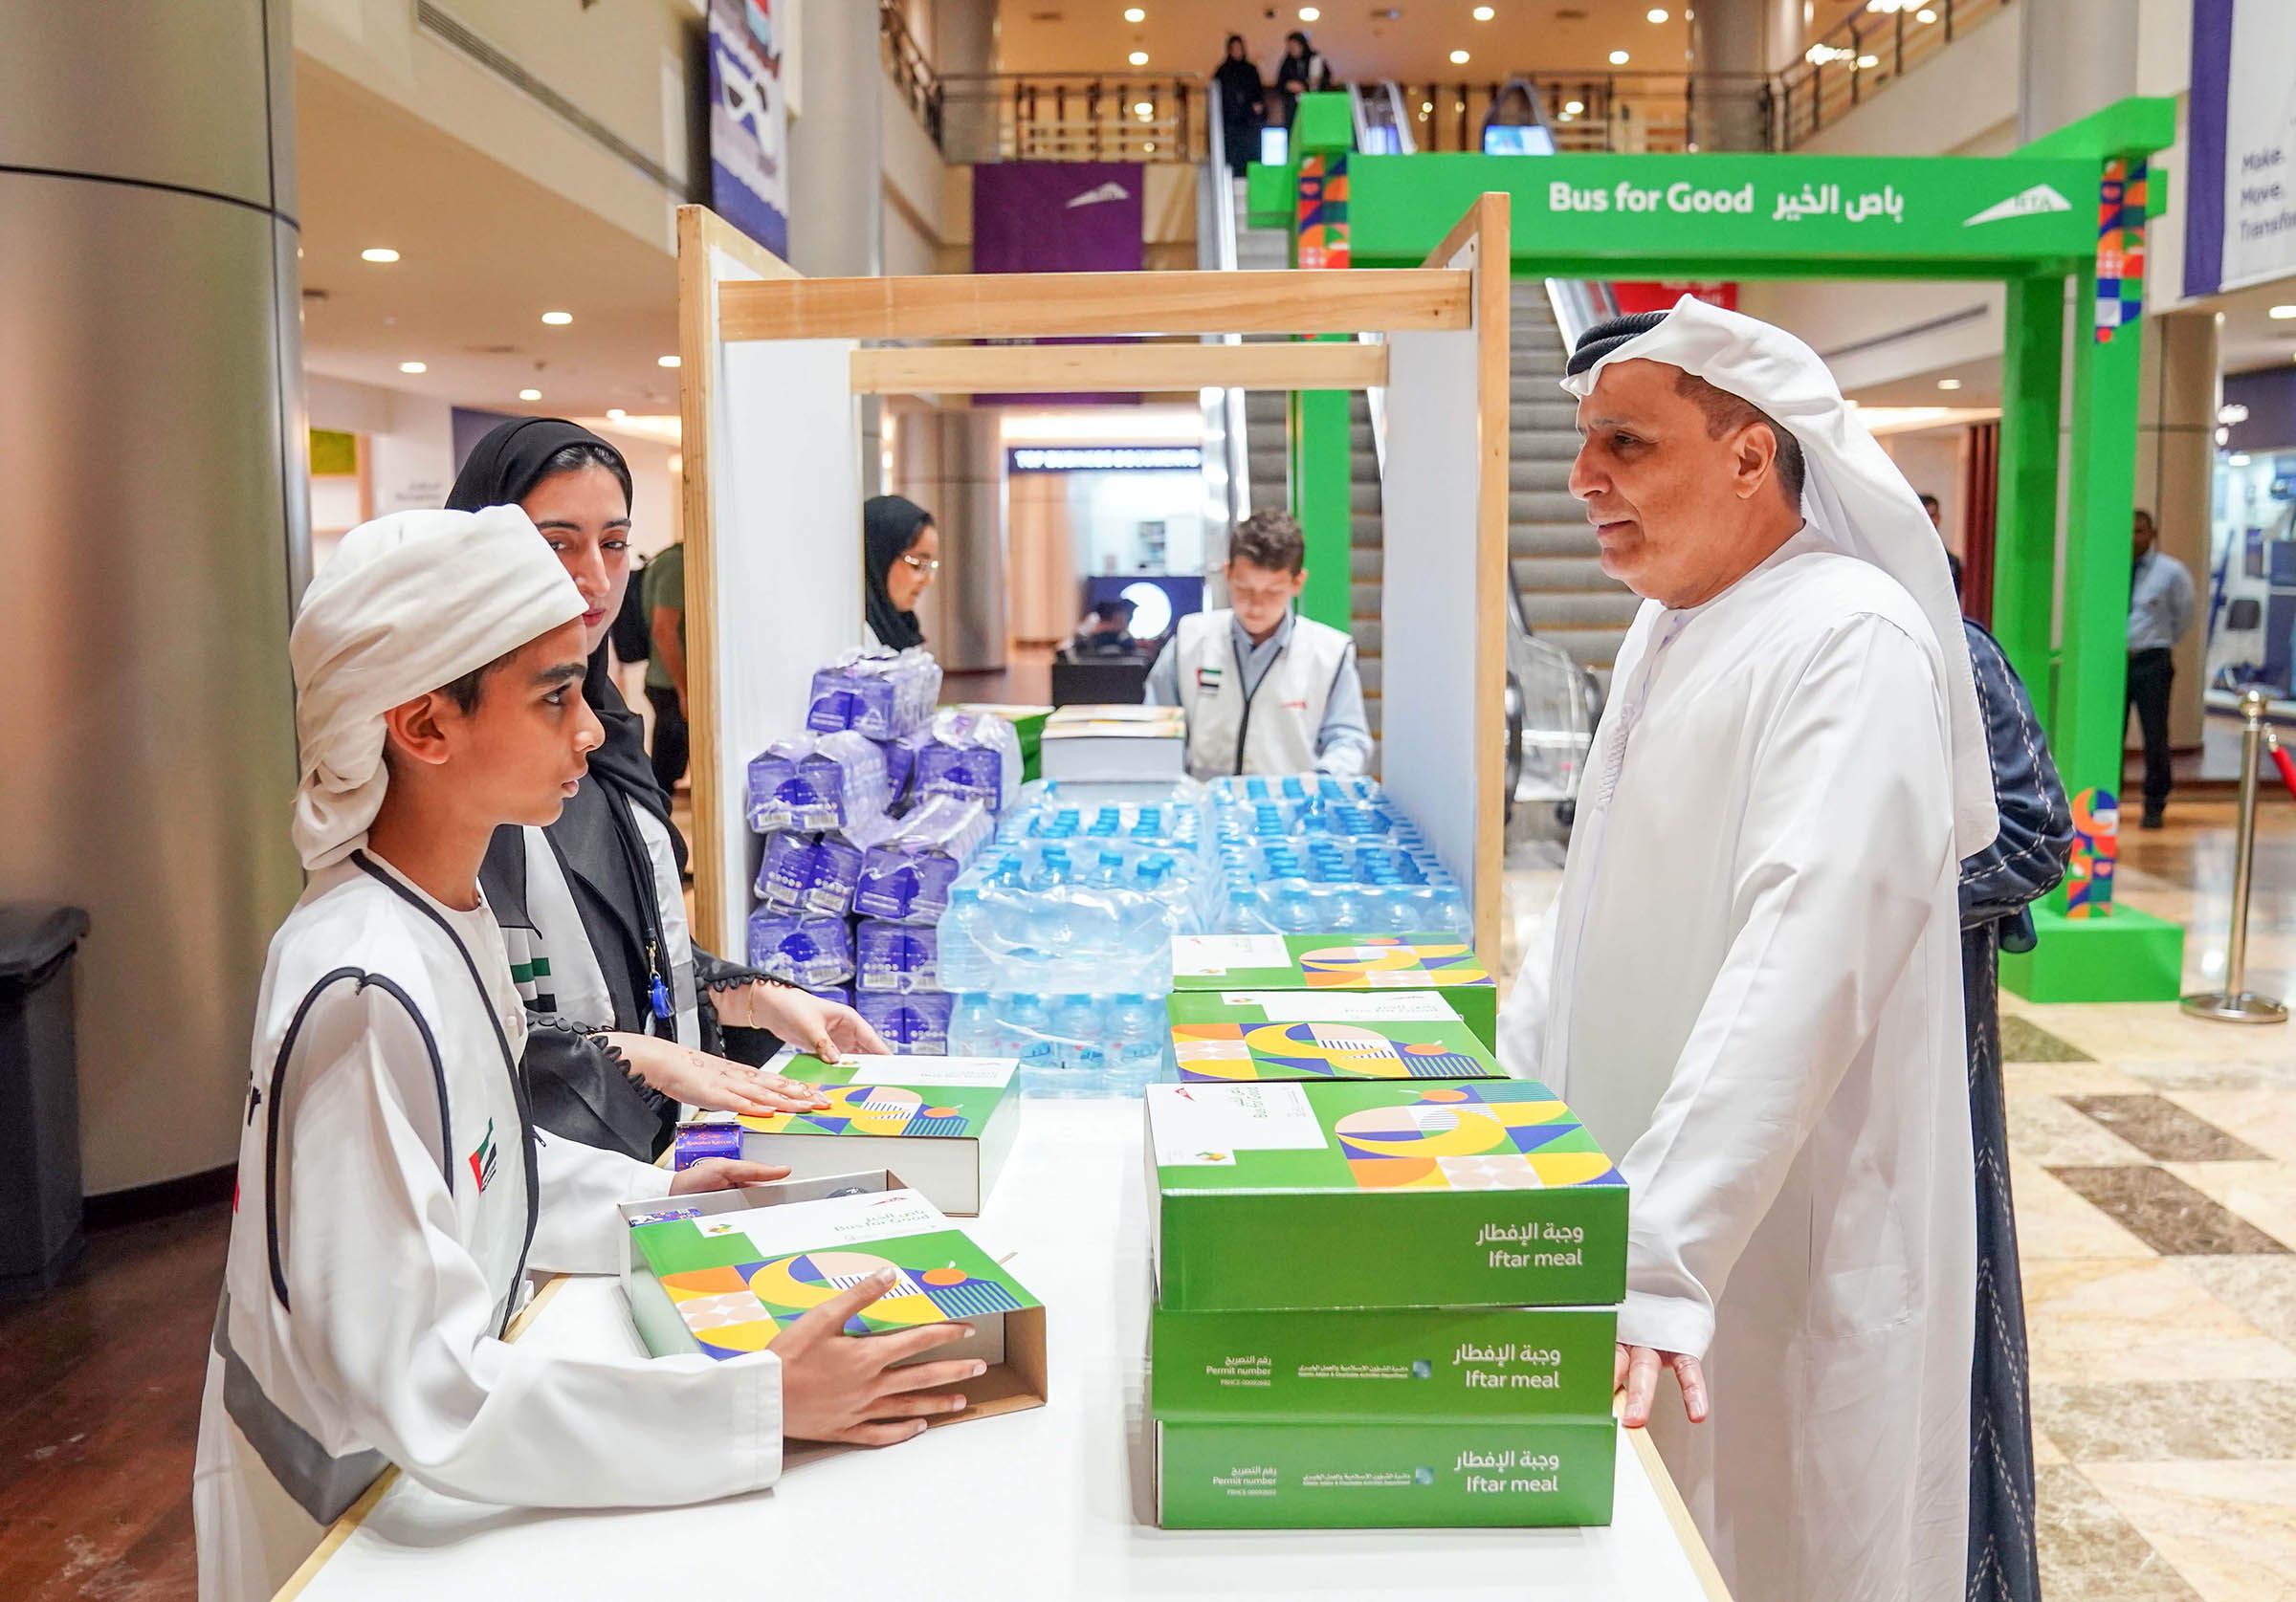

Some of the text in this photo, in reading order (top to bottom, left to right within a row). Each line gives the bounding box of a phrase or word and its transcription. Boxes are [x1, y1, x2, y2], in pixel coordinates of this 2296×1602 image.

[1550, 182, 1755, 213] Bus for Good
[1773, 184, 1904, 223] باص الخير
[1476, 1222, 1584, 1246] وجبة الإفطار
[1489, 1248, 1583, 1268] Iftar meal
[1452, 1343, 1561, 1366] وجبة الإفطار
[1205, 1365, 1271, 1375] Permit number
[1466, 1370, 1560, 1389] Iftar meal
[1454, 1450, 1559, 1472] وجبة الإفطار
[1212, 1476, 1277, 1485] Permit number
[1467, 1474, 1558, 1493] Iftar meal
